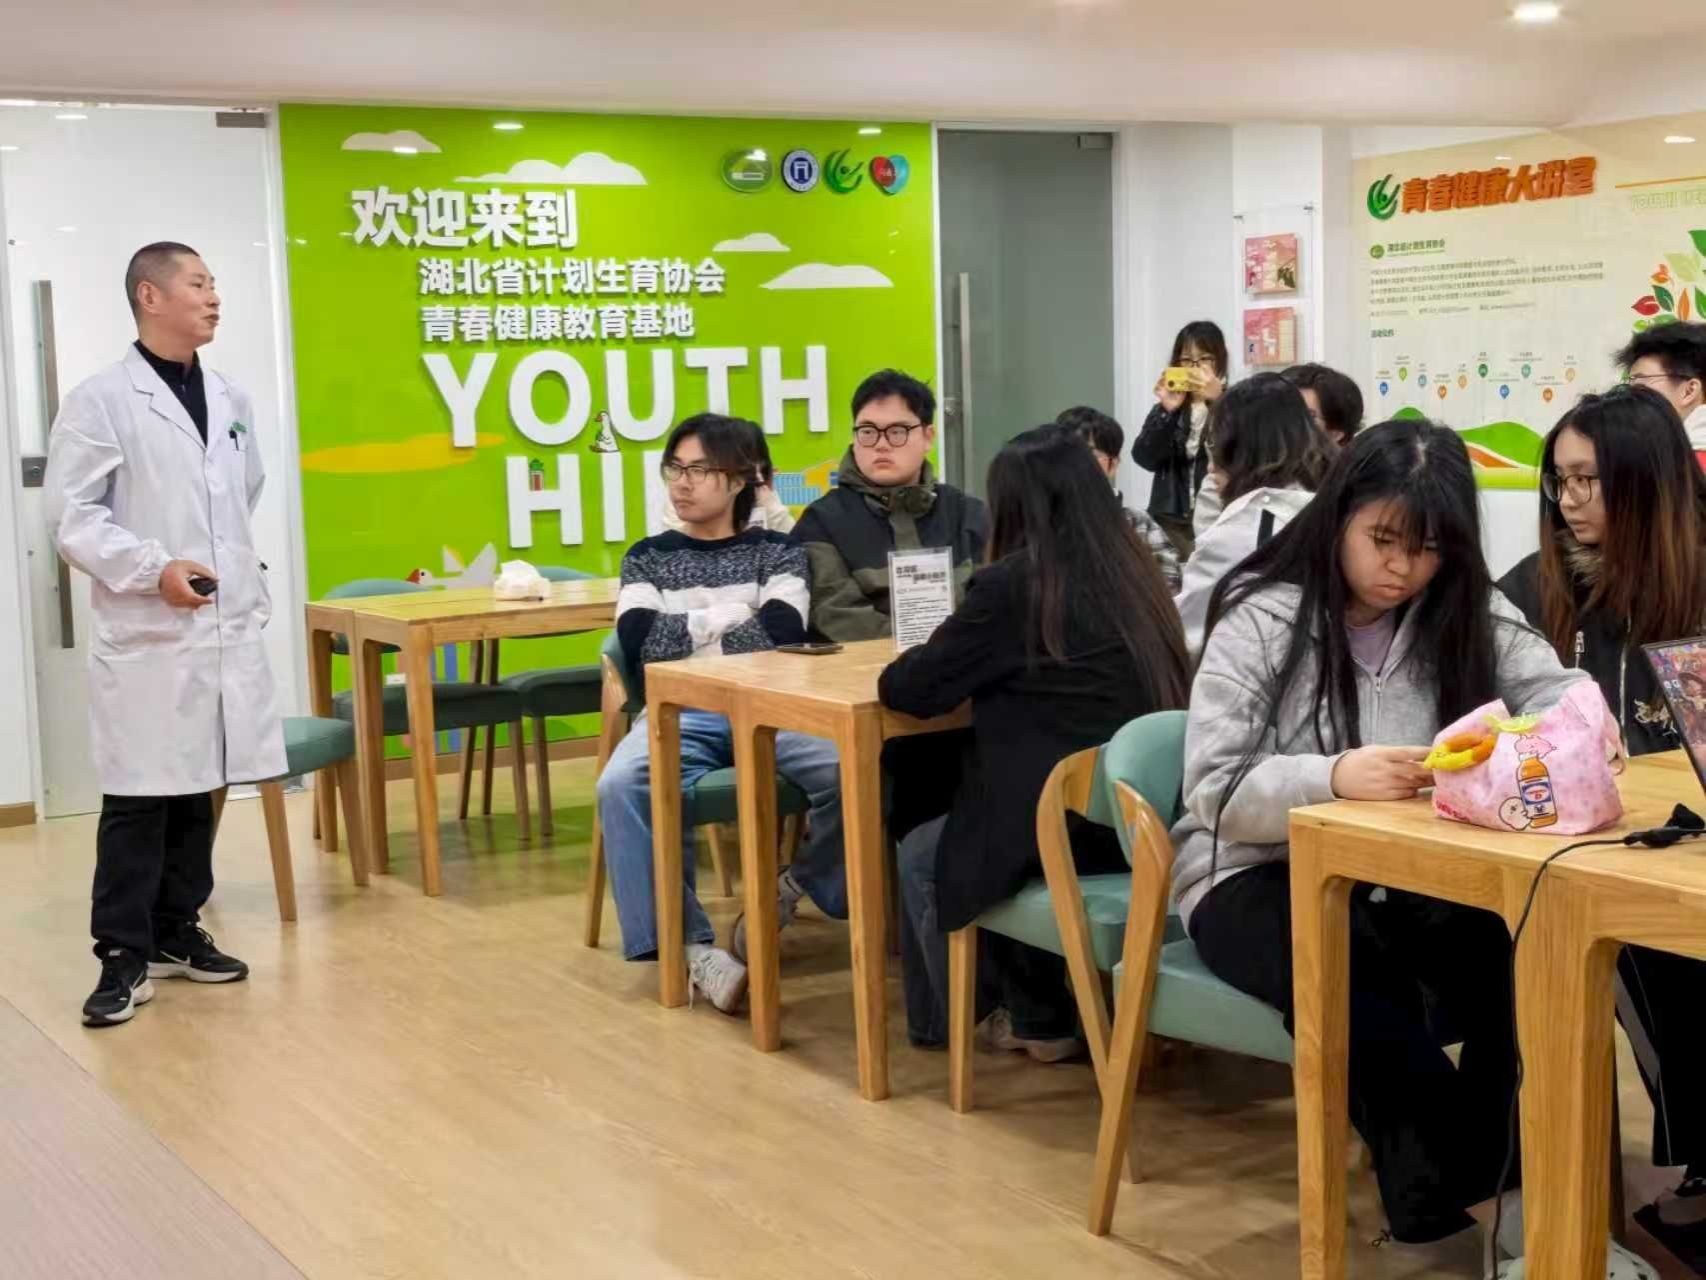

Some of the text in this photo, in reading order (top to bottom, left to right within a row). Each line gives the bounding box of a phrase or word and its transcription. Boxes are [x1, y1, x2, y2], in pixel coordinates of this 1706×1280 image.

[351, 186, 578, 248] 欢迎来到
[419, 257, 726, 295] 湖北省计划生育协会
[421, 303, 696, 342] 青春健康教育基地
[422, 345, 830, 448] YOUTH
